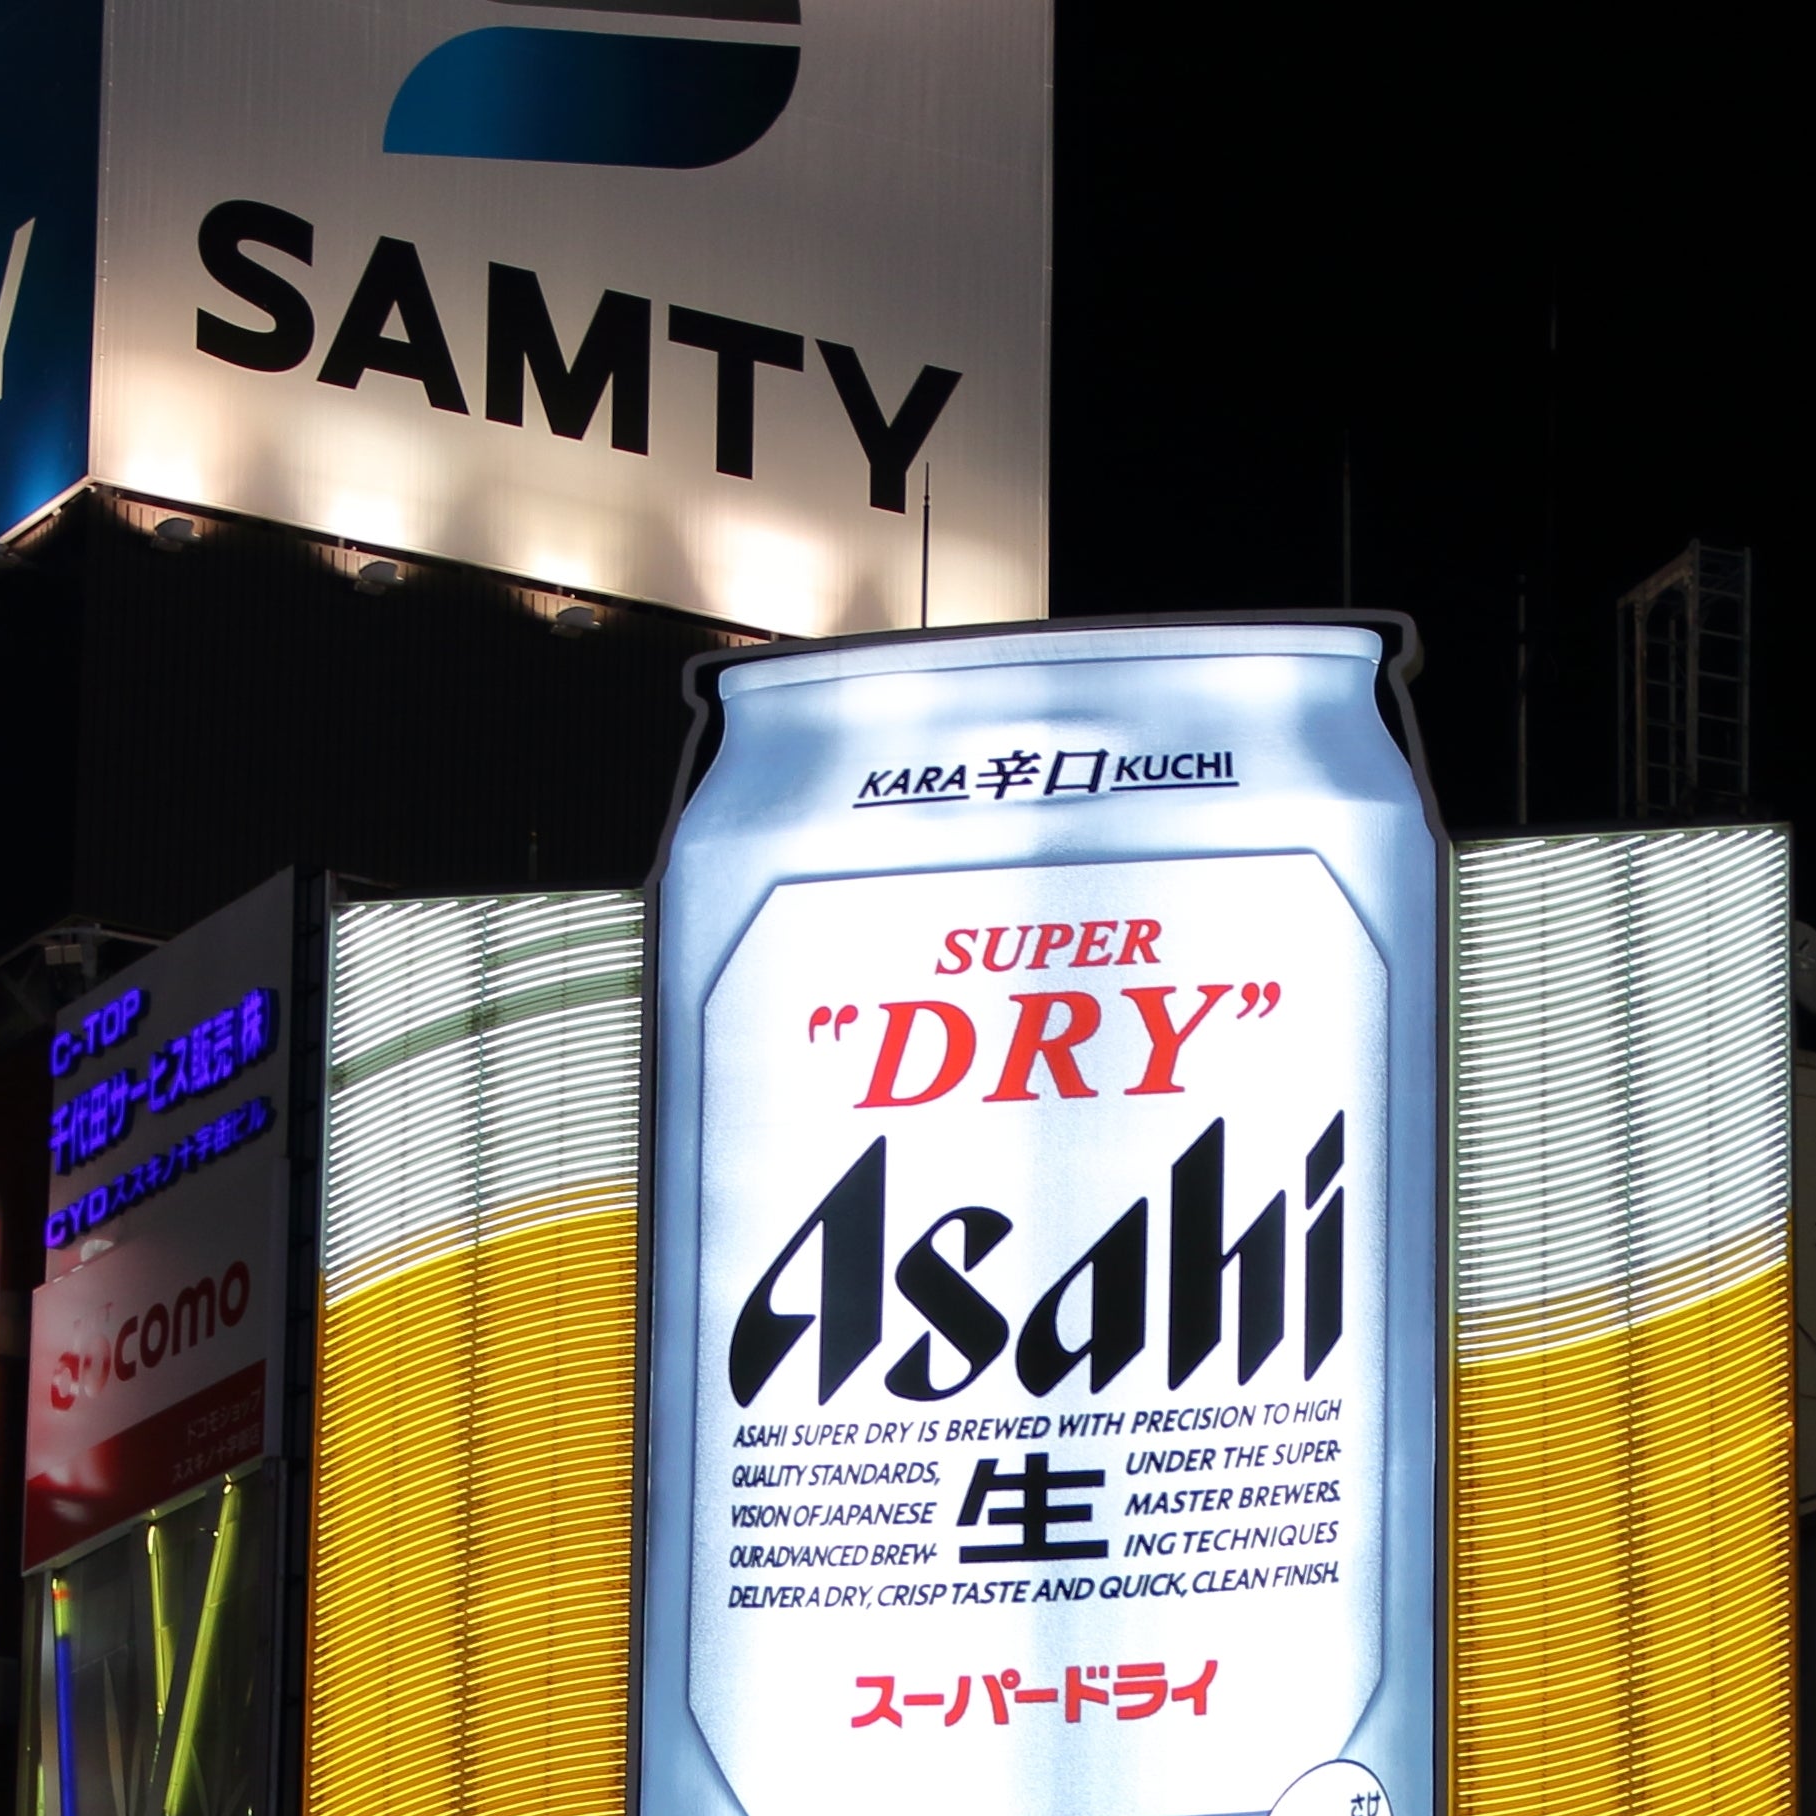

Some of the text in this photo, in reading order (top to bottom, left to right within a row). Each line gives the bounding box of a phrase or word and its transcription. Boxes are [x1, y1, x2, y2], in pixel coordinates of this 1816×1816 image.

[196, 199, 962, 513] SAMTY
[857, 749, 1234, 800] KARA 辛口 KUCHI
[935, 919, 1162, 976] SUPER
[51, 987, 143, 1077] C-TOP
[729, 1110, 1345, 1408] Asahi
[733, 1399, 1343, 1448] ASAHI SUPER DRY IS BREWED WITH PRECISION TO HIGH
[732, 1461, 941, 1488] QUALITY STANDARDS,
[1125, 1439, 1342, 1475] UNDER THE SUPER-
[731, 1502, 937, 1528] VISION OF JAPANESE
[956, 1452, 1109, 1564] 生
[1125, 1487, 1233, 1516] MASTER
[730, 1543, 938, 1568] OUR ADVANCED BREW-
[1124, 1521, 1339, 1558] ING TECHNIQUES
[728, 1585, 805, 1609] DELIVER
[804, 1585, 820, 1608] A
[824, 1584, 874, 1610] DRY,
[877, 1583, 947, 1607] CRISP
[951, 1580, 1031, 1605] TASTE
[1031, 1576, 1095, 1603] AND
[1099, 1571, 1188, 1600] QUICK,
[1192, 1568, 1269, 1594] CLEAN
[852, 1660, 1218, 1729] スーパードライ
